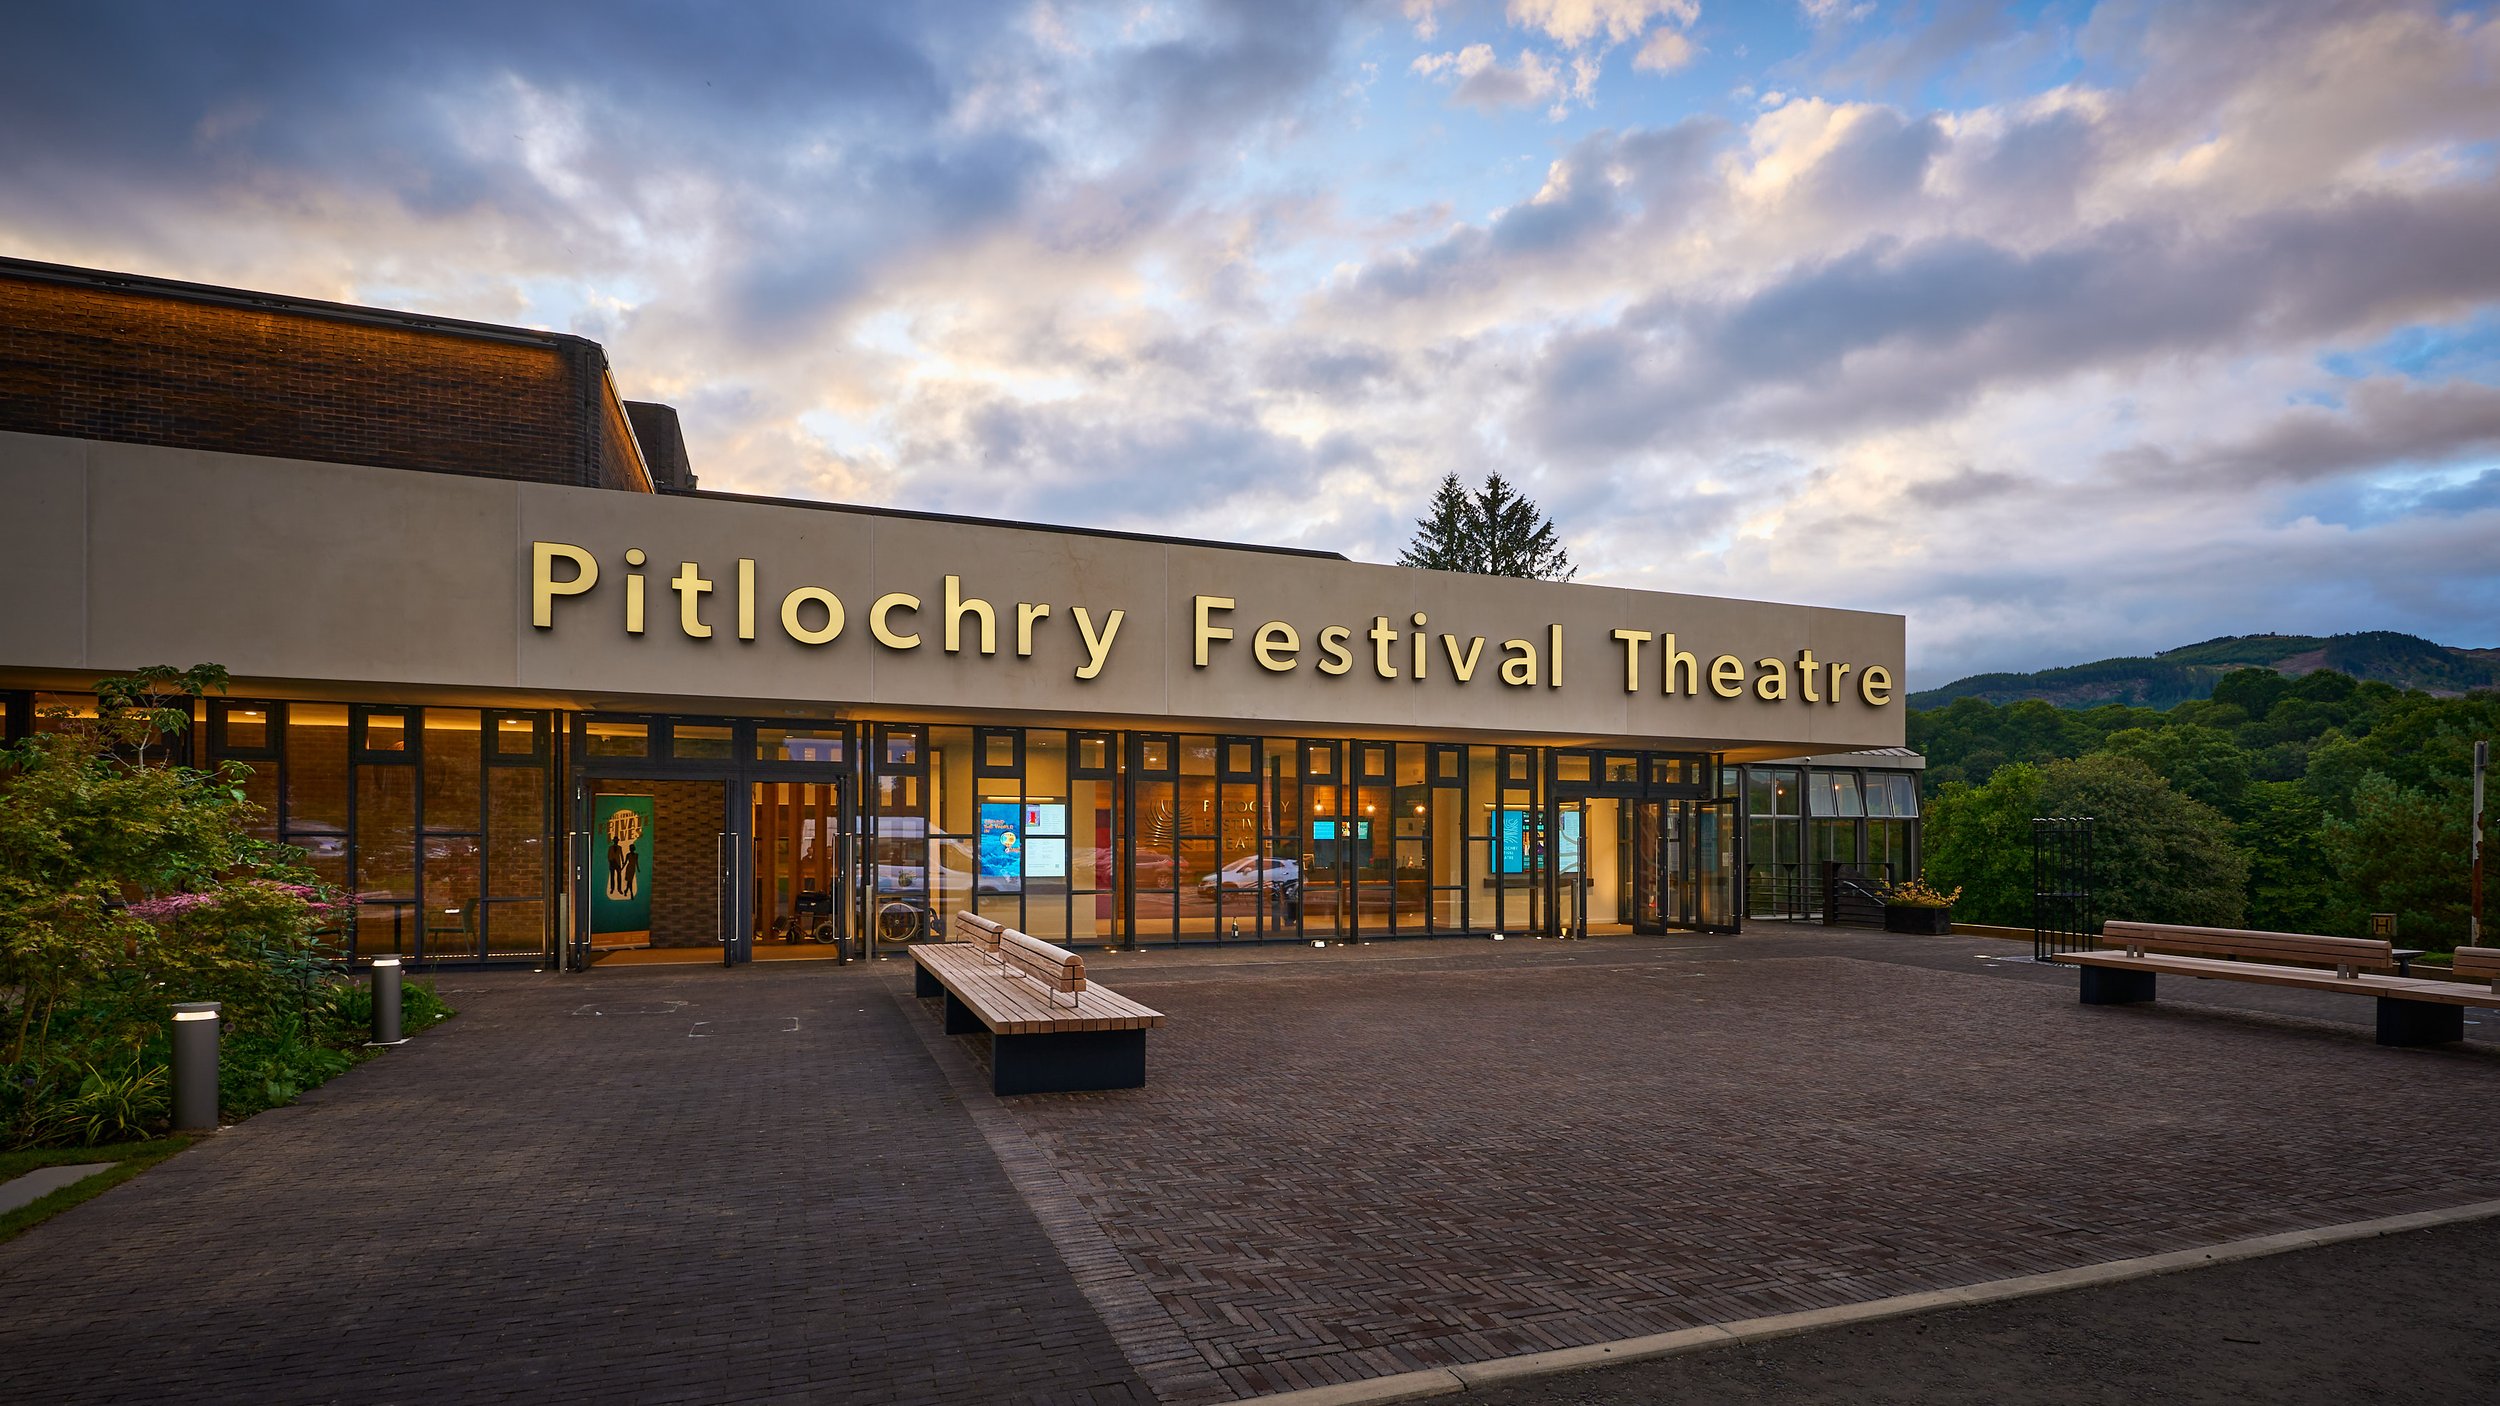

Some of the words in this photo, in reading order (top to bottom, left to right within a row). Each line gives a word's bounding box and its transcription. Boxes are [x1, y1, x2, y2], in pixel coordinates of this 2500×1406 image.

[531, 540, 1126, 681] Pitlochry
[1191, 594, 1564, 690] Festival
[1610, 627, 1893, 707] Theatre
[597, 815, 650, 836] PRIVATE
[606, 827, 643, 843] LIVES
